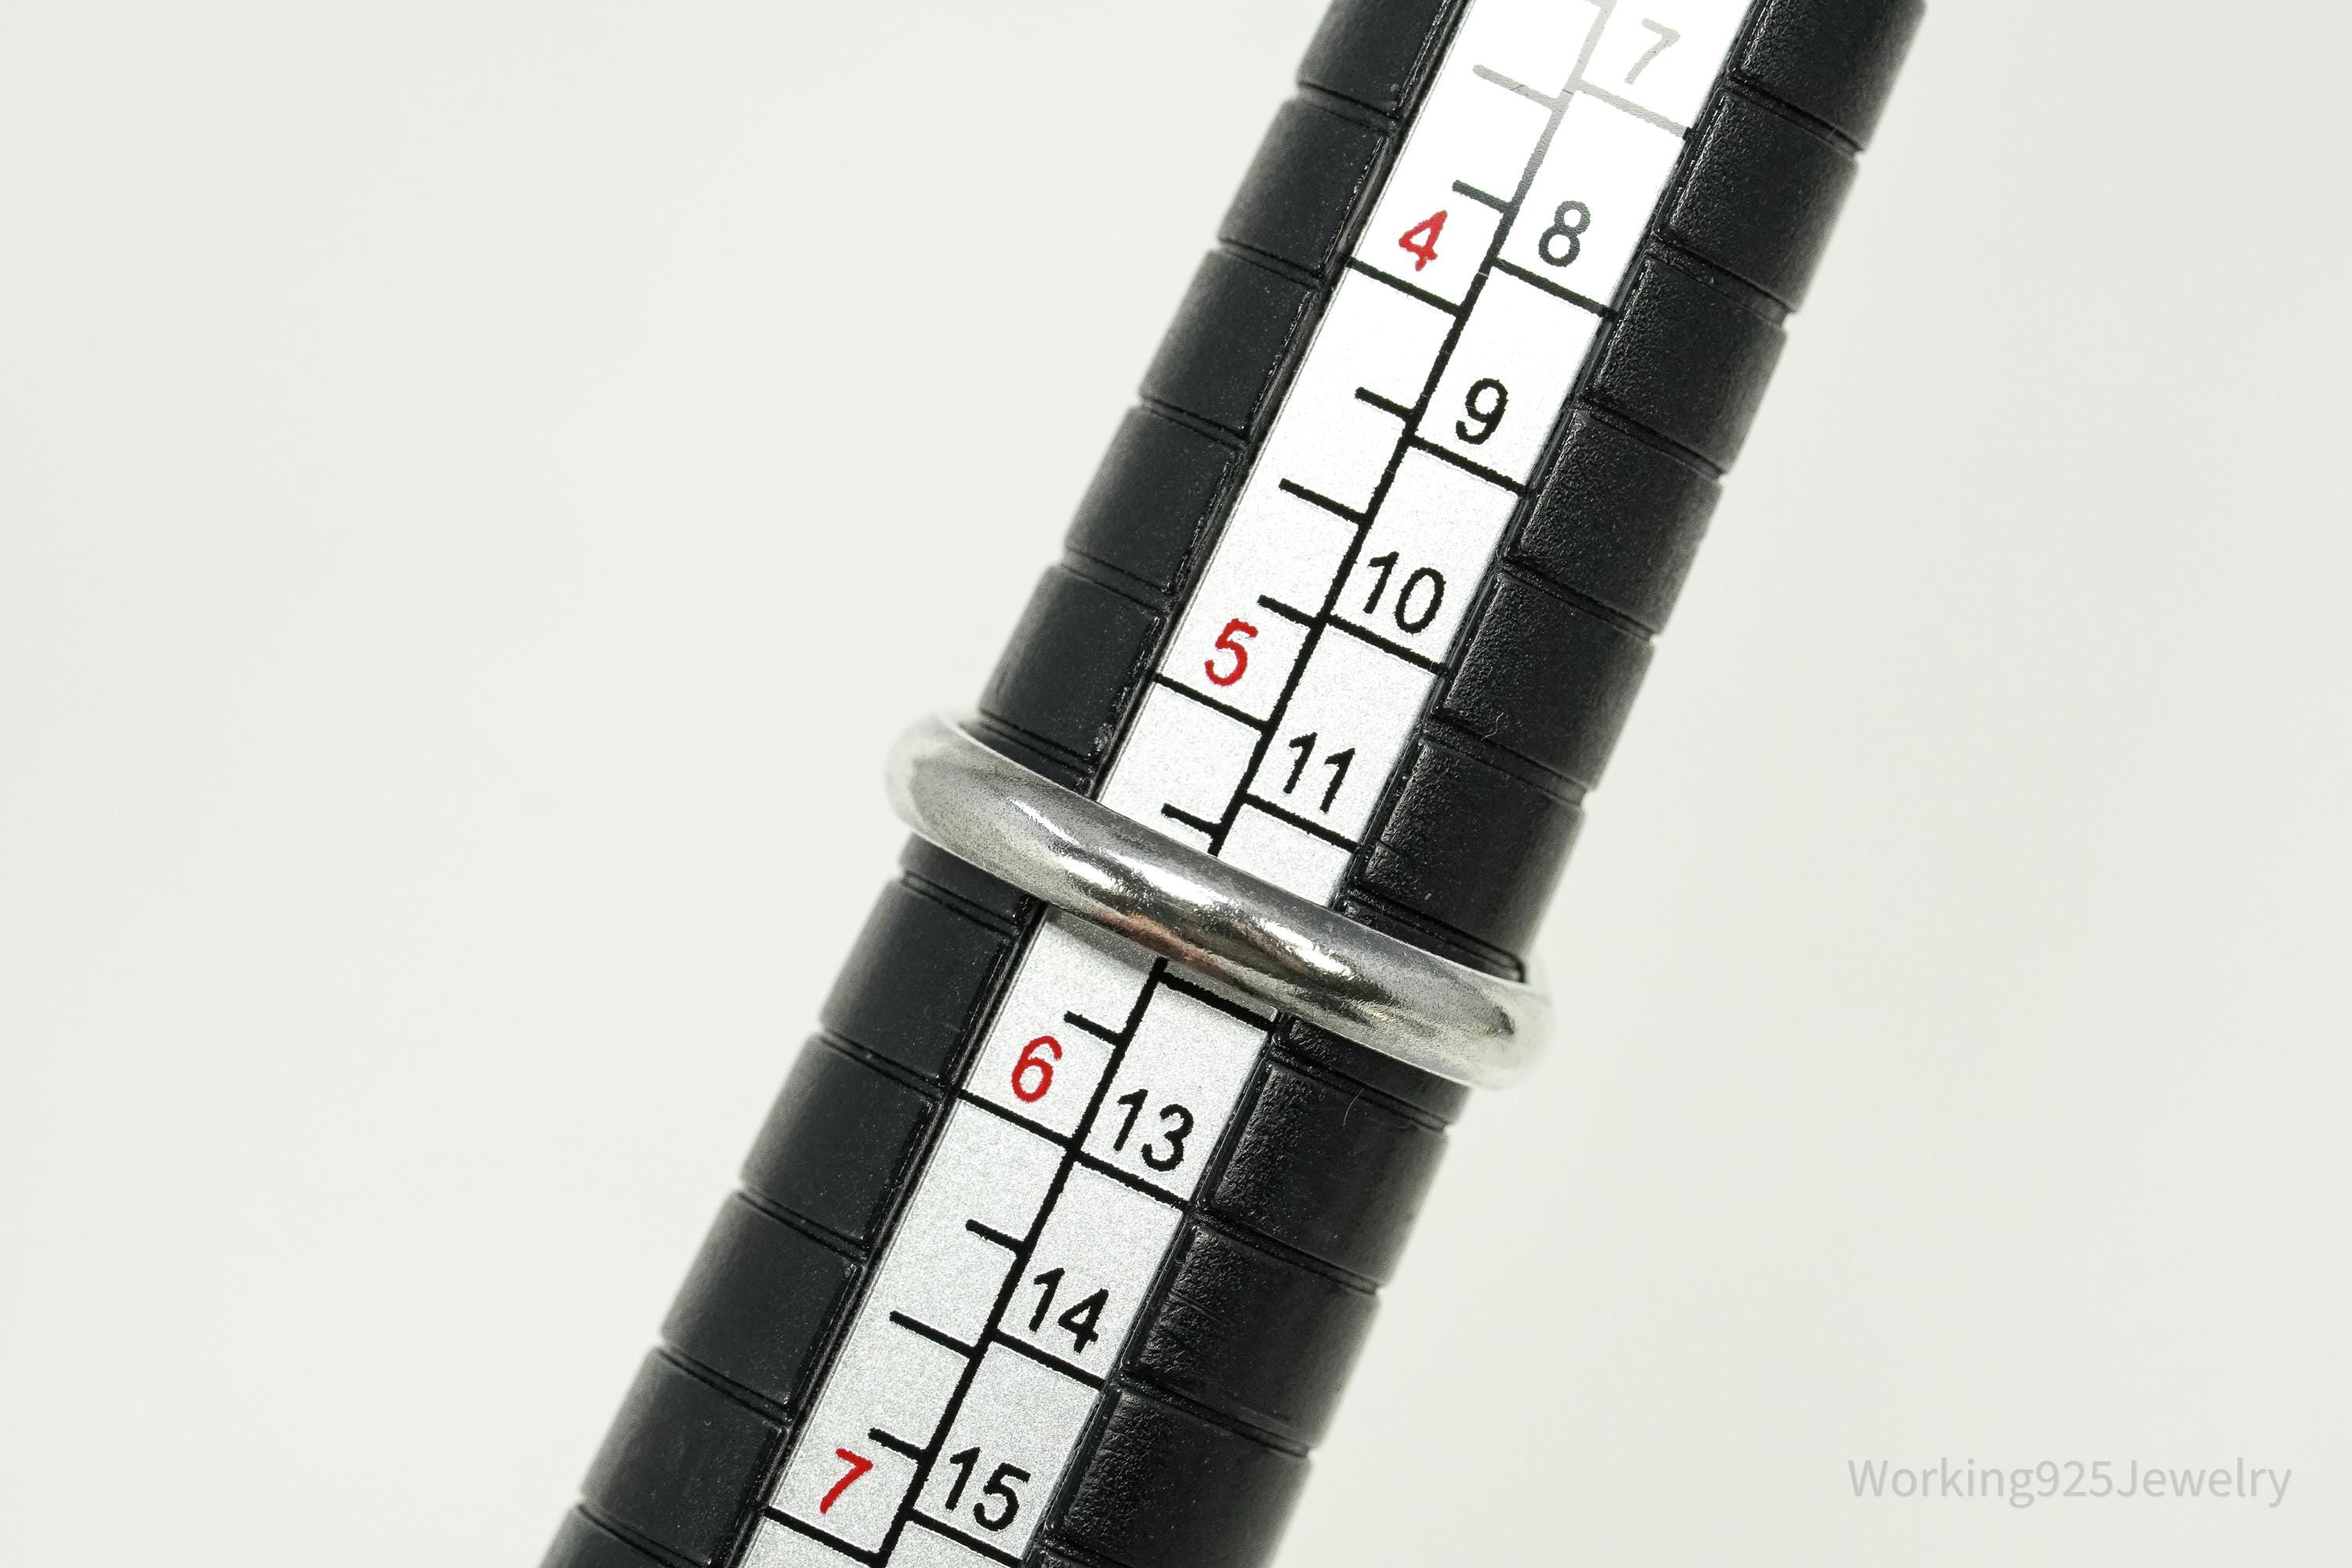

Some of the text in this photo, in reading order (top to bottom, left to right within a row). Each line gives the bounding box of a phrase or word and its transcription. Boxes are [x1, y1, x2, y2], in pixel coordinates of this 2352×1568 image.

[1624, 17, 1680, 85] 7
[1398, 210, 1447, 271] 4
[1537, 200, 1592, 268] 8
[1455, 377, 1509, 446] 9
[1363, 550, 1447, 636] 10
[1204, 617, 1259, 688] 5
[1283, 731, 1356, 814] 11
[1011, 1034, 1063, 1104] 6
[1113, 1088, 1195, 1173] 13
[1029, 1267, 1109, 1355] 14
[818, 1447, 873, 1515] 7
[945, 1446, 1031, 1530] 15
